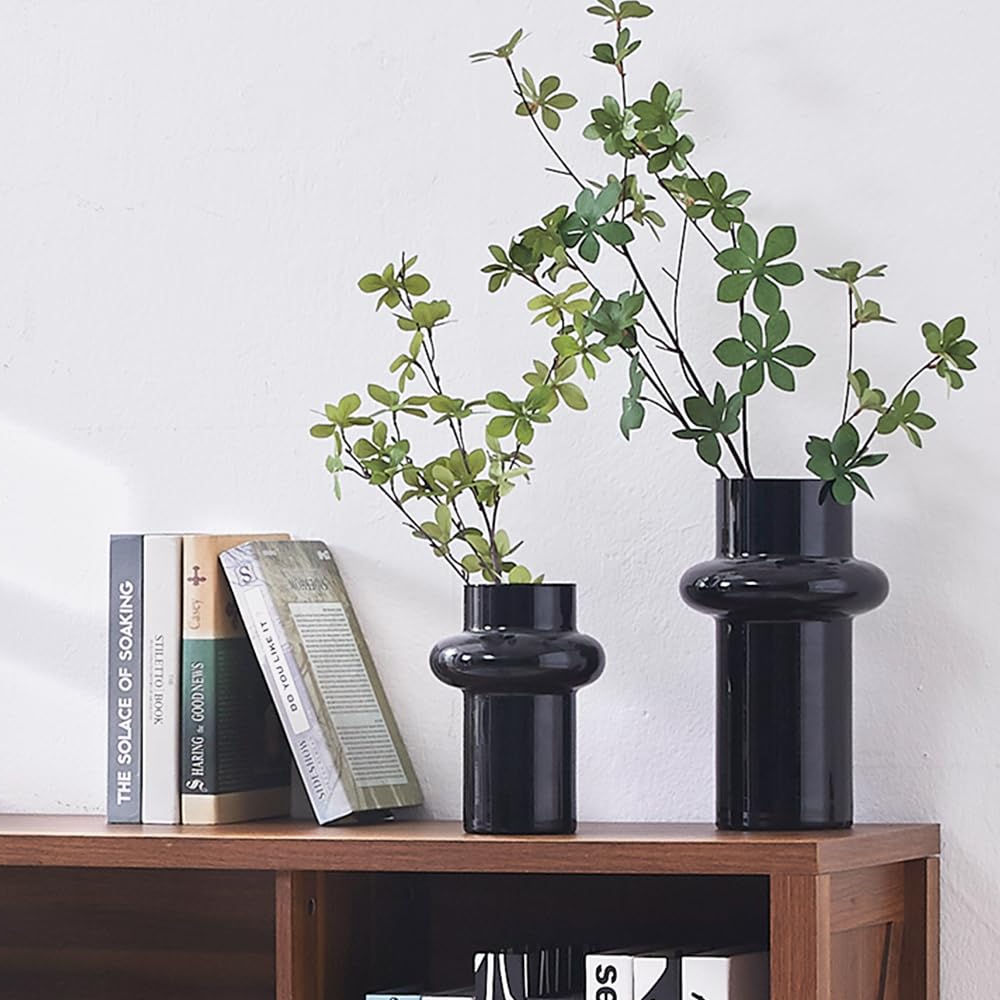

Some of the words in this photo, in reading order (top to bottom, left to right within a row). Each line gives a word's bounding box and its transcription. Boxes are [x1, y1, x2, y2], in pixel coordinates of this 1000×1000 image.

[118, 580, 134, 661] SOAKING
[259, 620, 268, 635] IT
[153, 634, 163, 688] STILETTO
[265, 636, 280, 663] LIKE
[118, 665, 133, 691] OF
[276, 666, 289, 690] YOU
[153, 693, 164, 726] BOOK
[287, 693, 298, 712] DO
[118, 695, 133, 765] SOLACE
[185, 736, 208, 793] SHARING
[298, 738, 326, 801] SIDESHOW
[117, 771, 132, 805] THE
